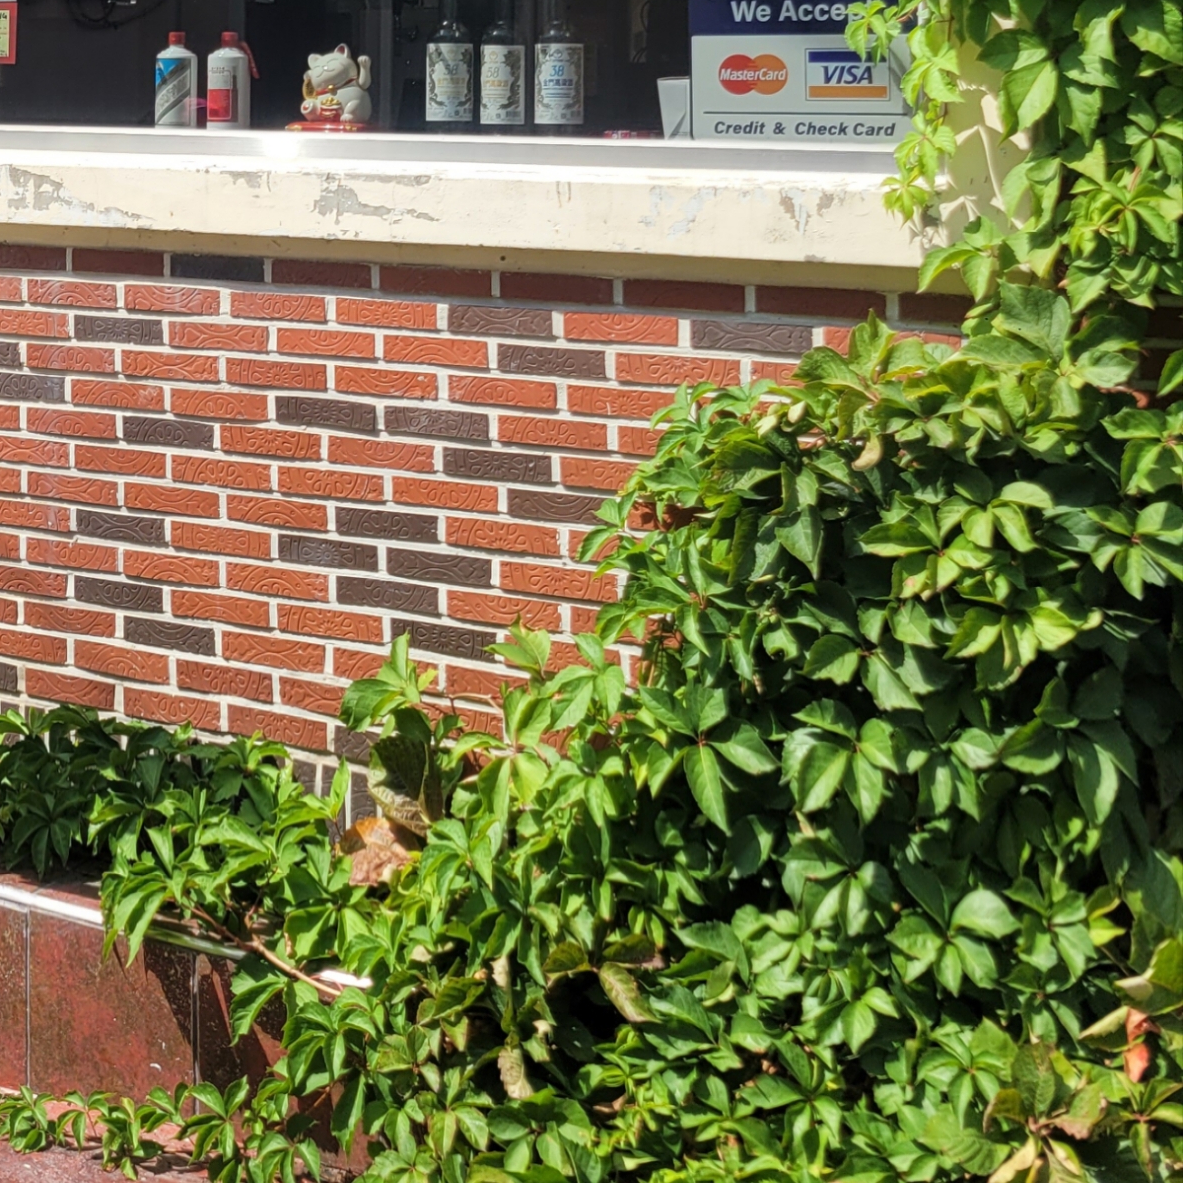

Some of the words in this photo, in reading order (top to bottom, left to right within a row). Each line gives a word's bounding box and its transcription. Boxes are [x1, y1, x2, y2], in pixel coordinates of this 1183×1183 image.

[730, 0, 771, 23] We
[444, 63, 459, 76] 58
[486, 67, 500, 79] 58
[549, 64, 565, 77] 38
[720, 68, 787, 82] MasterCard
[821, 65, 873, 84] VISA
[714, 121, 766, 135] Credit
[773, 122, 786, 135] &
[795, 122, 848, 136] Check
[853, 123, 896, 137] Card
